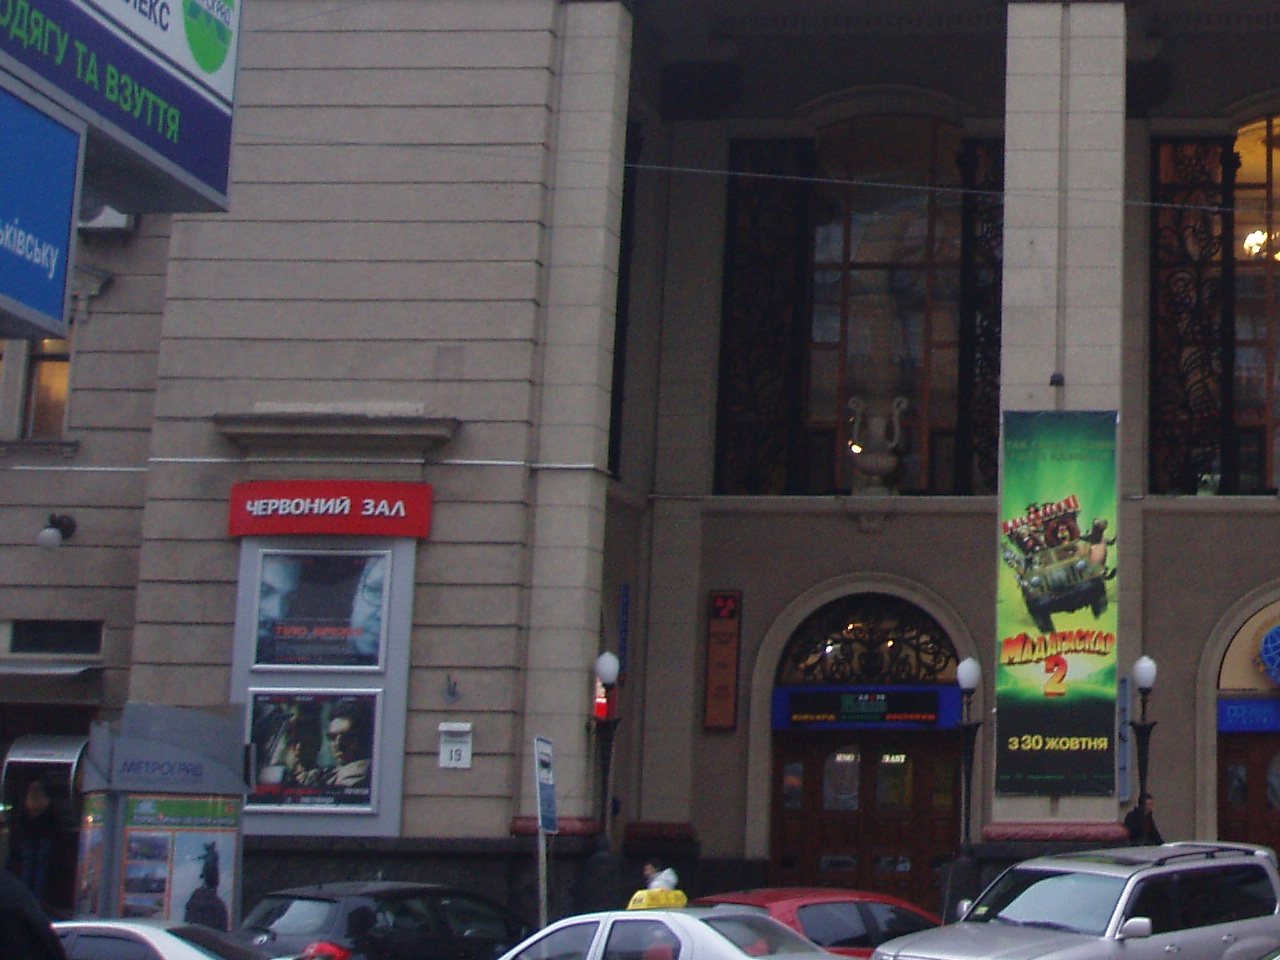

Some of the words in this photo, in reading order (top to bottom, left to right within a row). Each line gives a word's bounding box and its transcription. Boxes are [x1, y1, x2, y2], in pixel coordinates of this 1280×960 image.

[74, 40, 100, 91] ТА
[105, 63, 181, 143] ВЗУТТЯ
[246, 496, 351, 518] ЧЕРВОНИЙ
[361, 498, 407, 518] ЗАЛ
[1044, 654, 1069, 698] 2
[1021, 734, 1044, 752] 30
